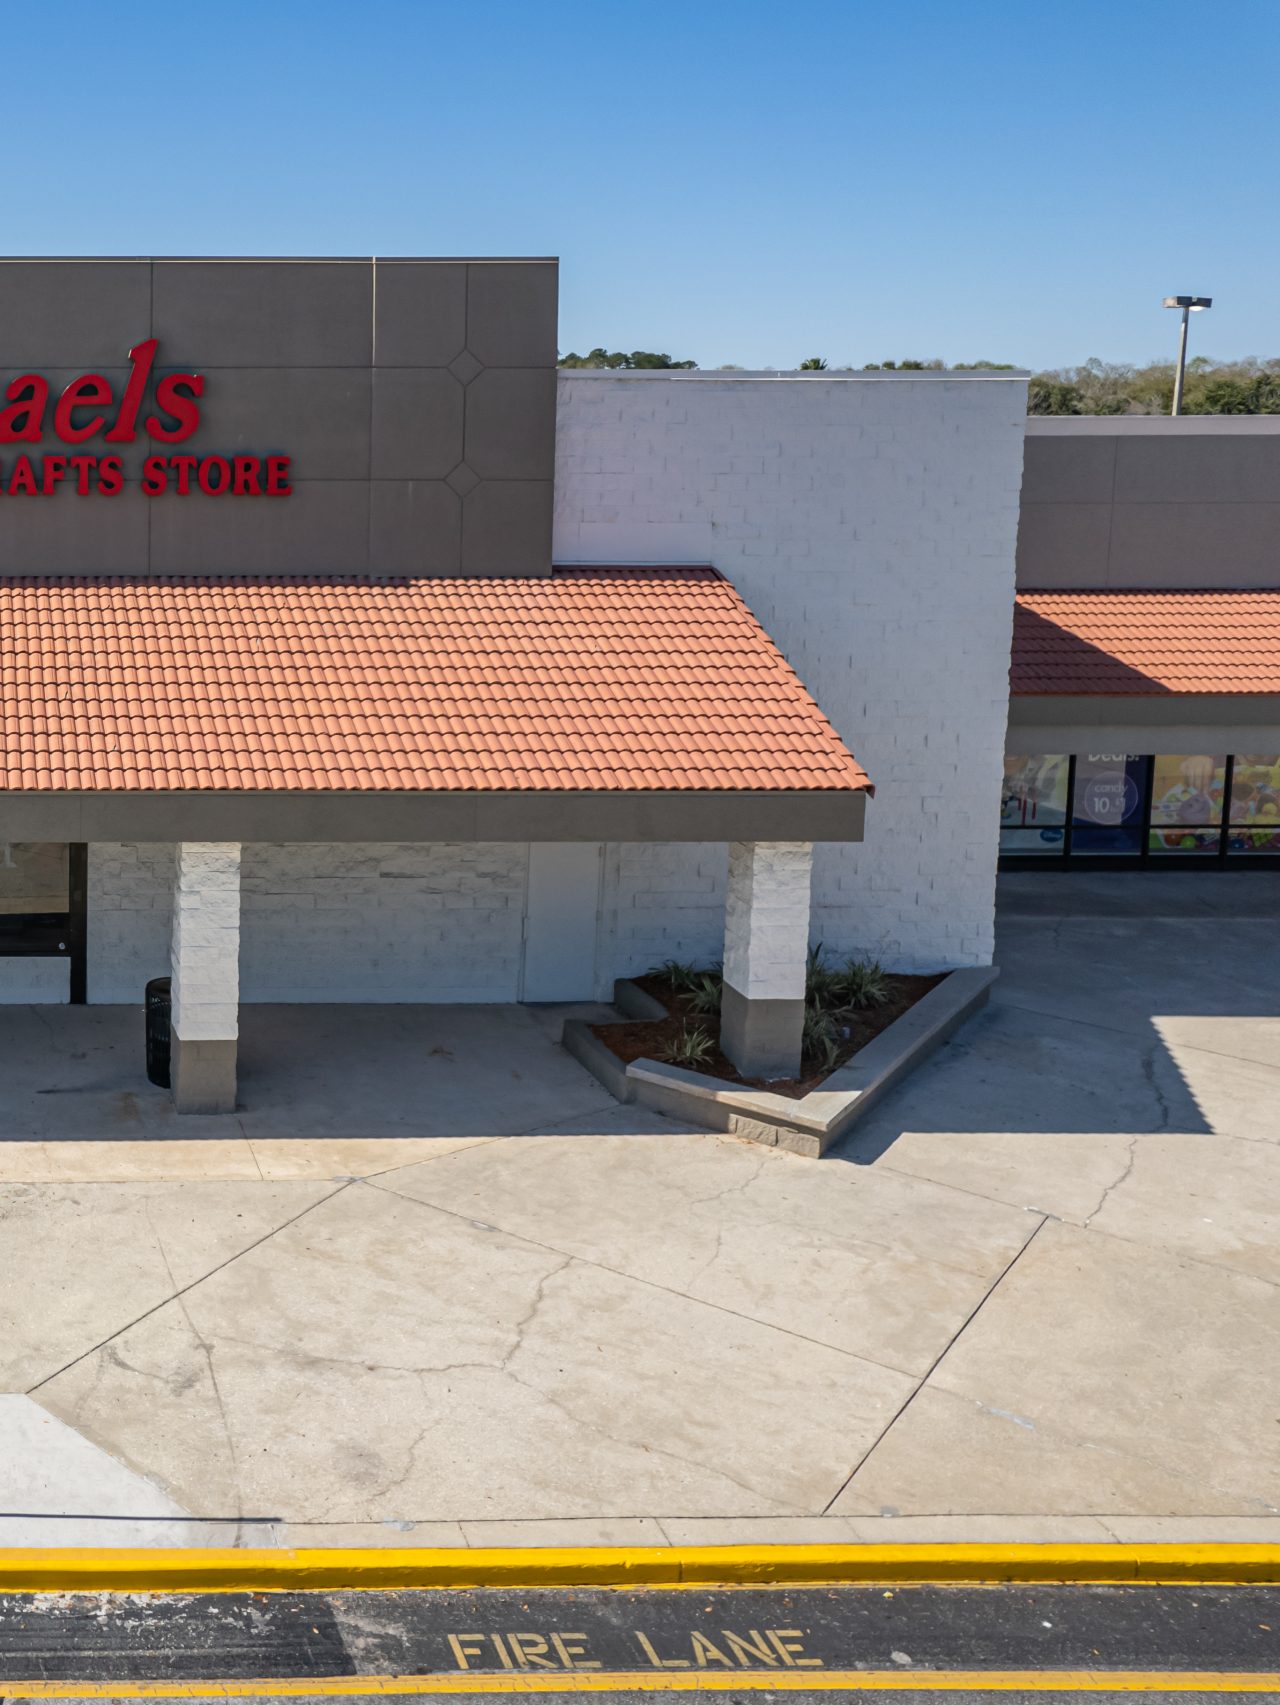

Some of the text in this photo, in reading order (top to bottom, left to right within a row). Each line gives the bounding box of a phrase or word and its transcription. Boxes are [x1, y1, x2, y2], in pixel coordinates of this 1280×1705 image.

[141, 455, 293, 497] STORE
[1094, 781, 1128, 796] candy
[447, 1629, 824, 1669] FIRE LANE
